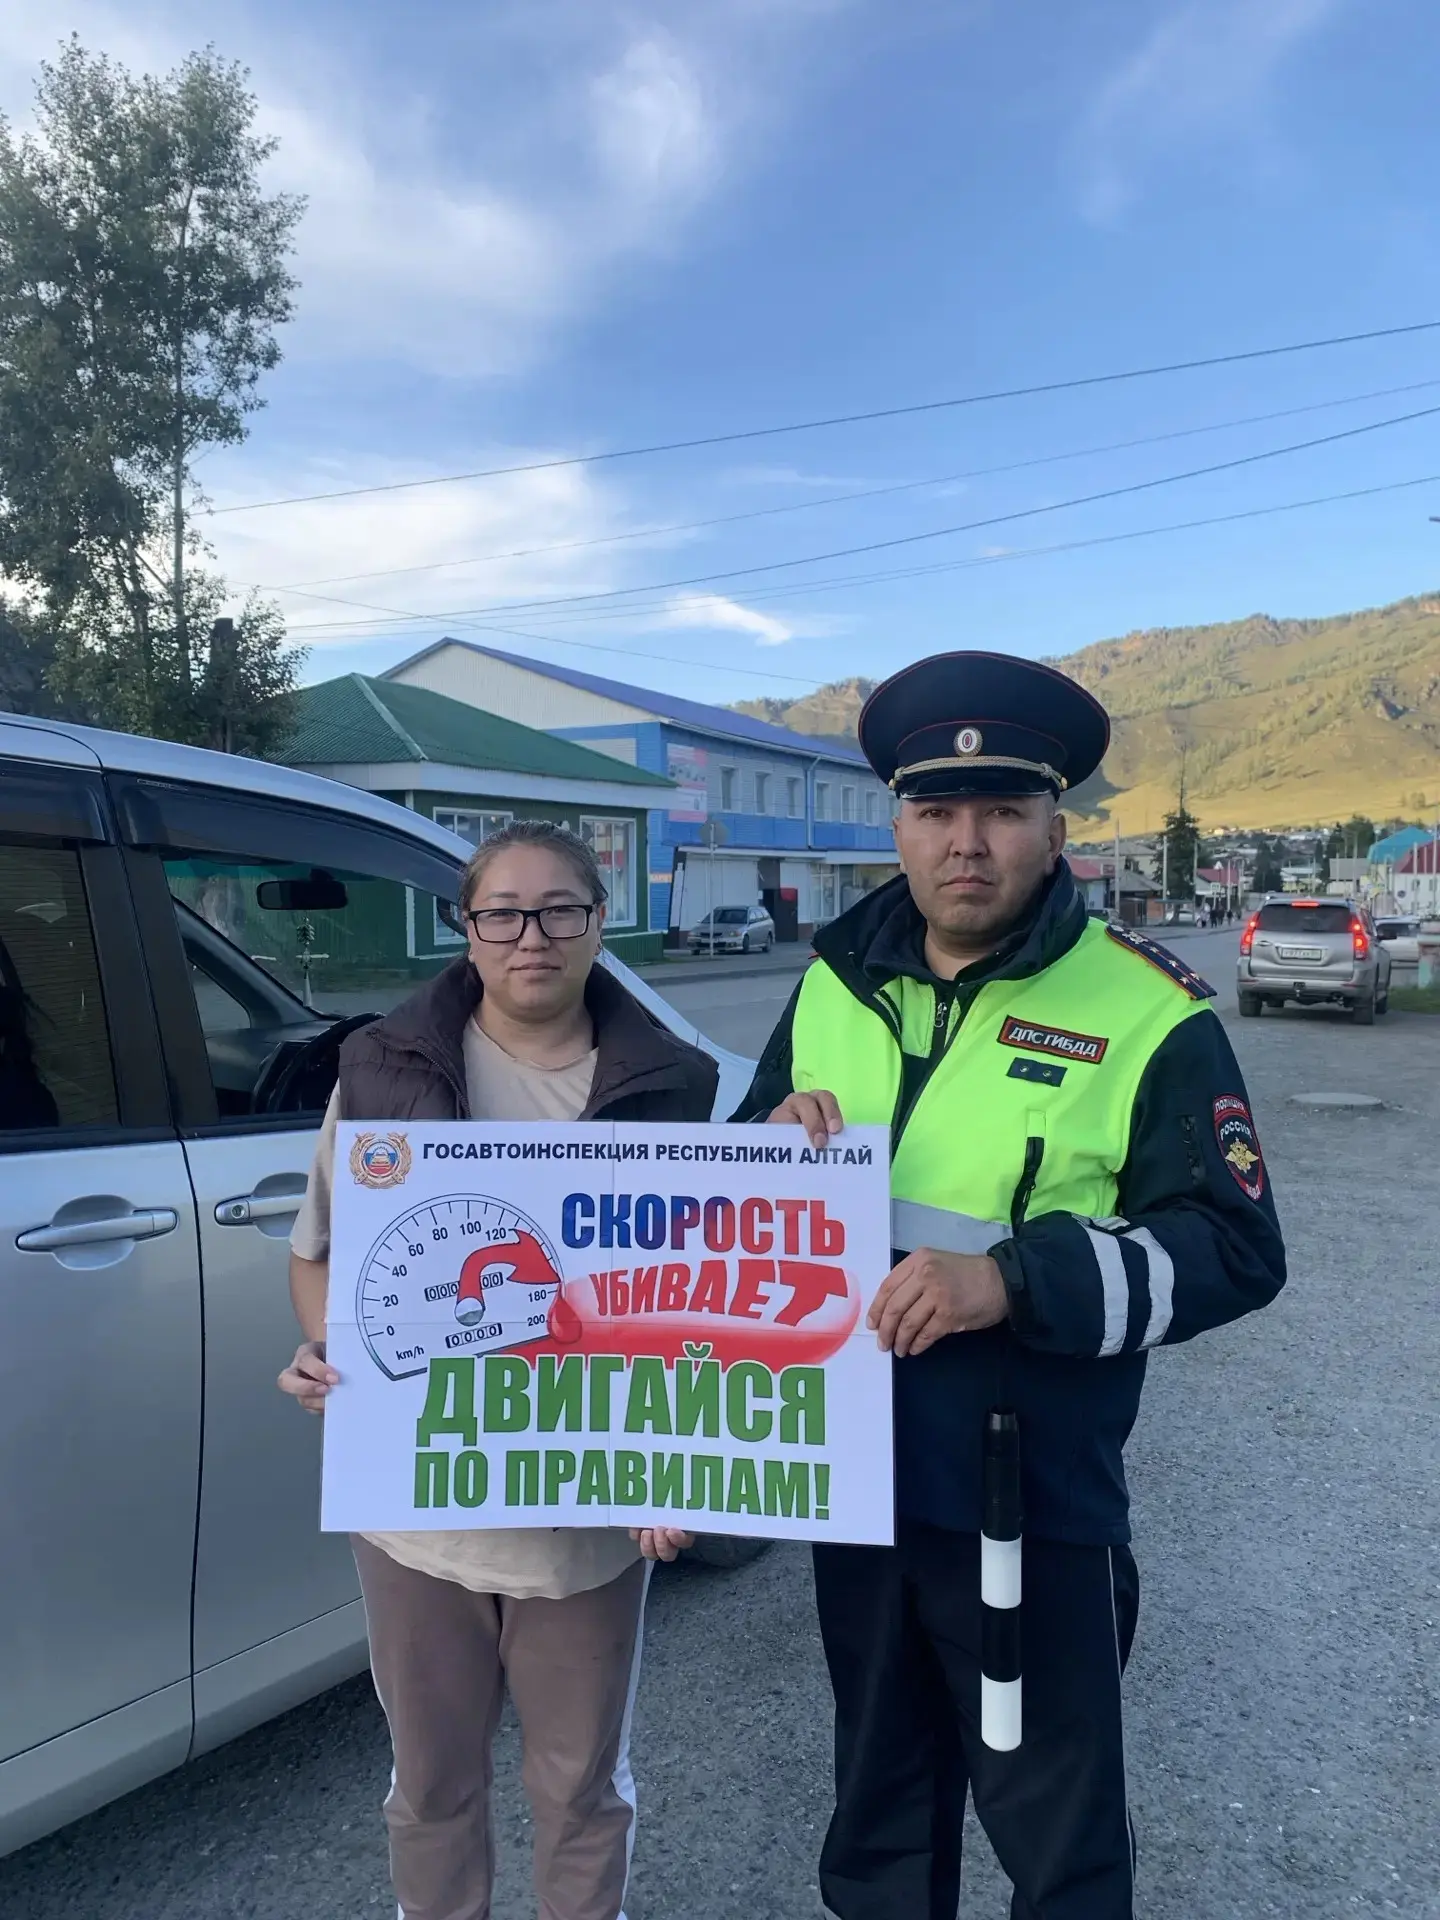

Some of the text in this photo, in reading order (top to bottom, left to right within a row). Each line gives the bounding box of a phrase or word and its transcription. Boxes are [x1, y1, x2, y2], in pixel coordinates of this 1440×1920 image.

[1008, 1026, 1098, 1058] ДПС ГИБДД
[1219, 1121, 1253, 1141] РОССИЯ
[422, 1142, 873, 1166] ГОСАВТОИНСПЕКЦИЯ РЕСПУБЛИКИ АЛТАЙ
[459, 1220, 482, 1236] 100
[561, 1192, 846, 1257] СКОРОСТЬ
[432, 1226, 449, 1242] 80
[485, 1229, 507, 1242] 120
[408, 1242, 425, 1257] 60
[391, 1264, 408, 1278] 40
[528, 1289, 547, 1303] 180
[589, 1258, 849, 1327] УБИВАЕТ
[382, 1294, 399, 1308] 20
[527, 1313, 546, 1327] 200
[386, 1325, 395, 1336] 0
[451, 1325, 497, 1345] 0000
[396, 1345, 425, 1361] km/h
[415, 1341, 826, 1447] ДВИГАЙСЯ
[413, 1448, 830, 1521] ПО ПРАВИЛАМ!
